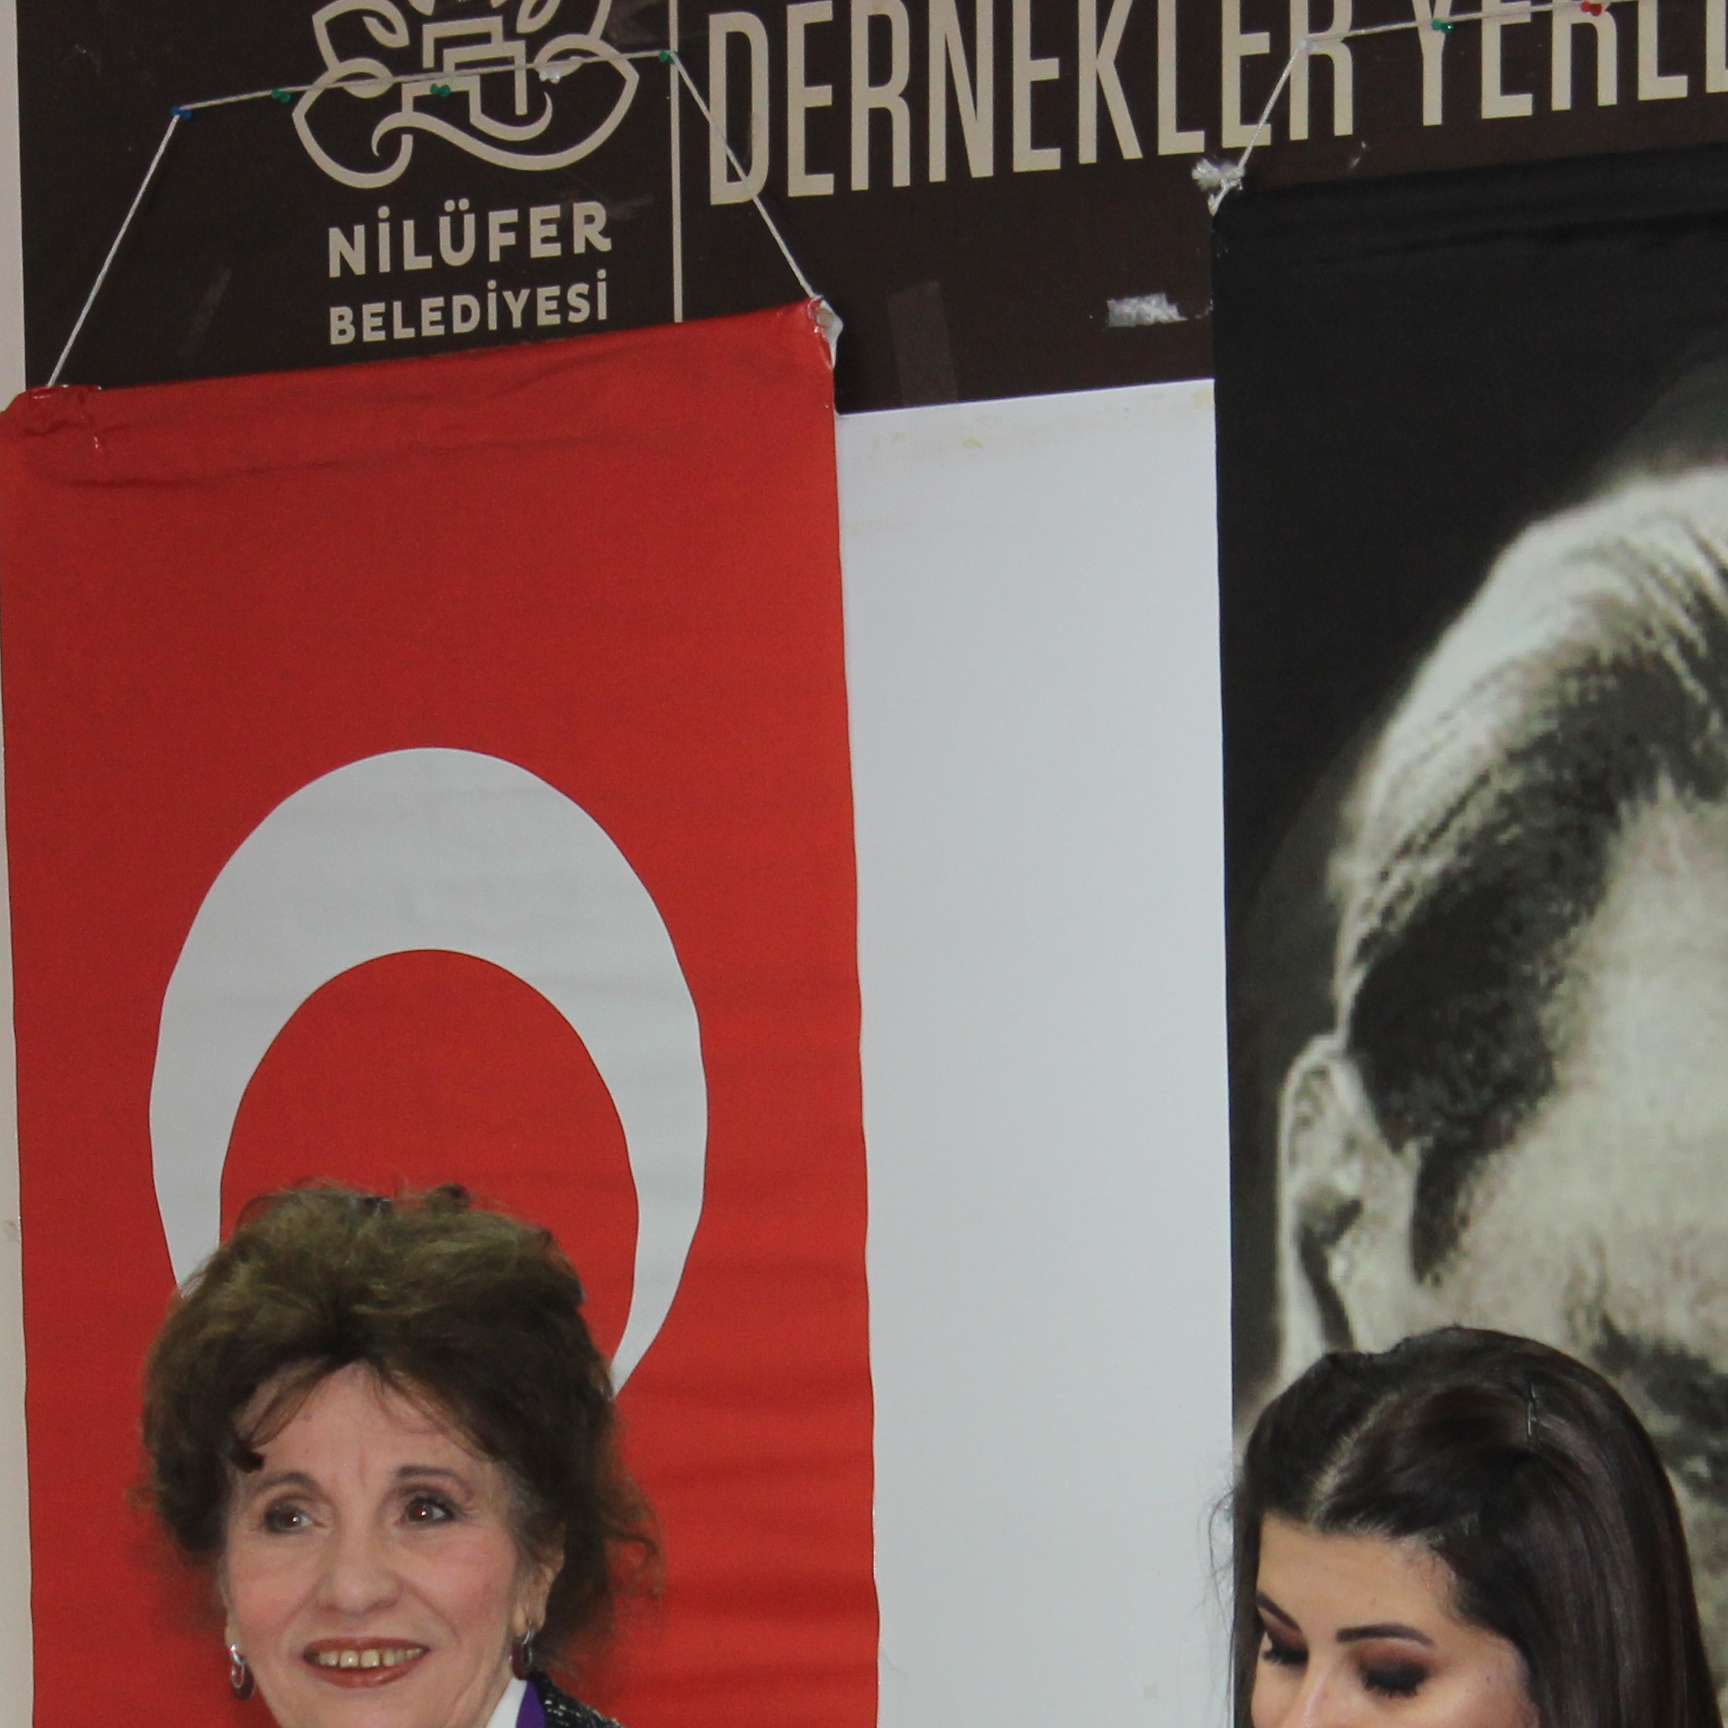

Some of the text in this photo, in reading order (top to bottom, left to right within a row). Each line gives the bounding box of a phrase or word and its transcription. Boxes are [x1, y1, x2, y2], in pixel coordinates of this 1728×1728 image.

[708, 0, 1355, 206] DERNEKLER
[328, 198, 612, 277] NİLÜFER
[329, 269, 608, 346] BELEDİYESİ
